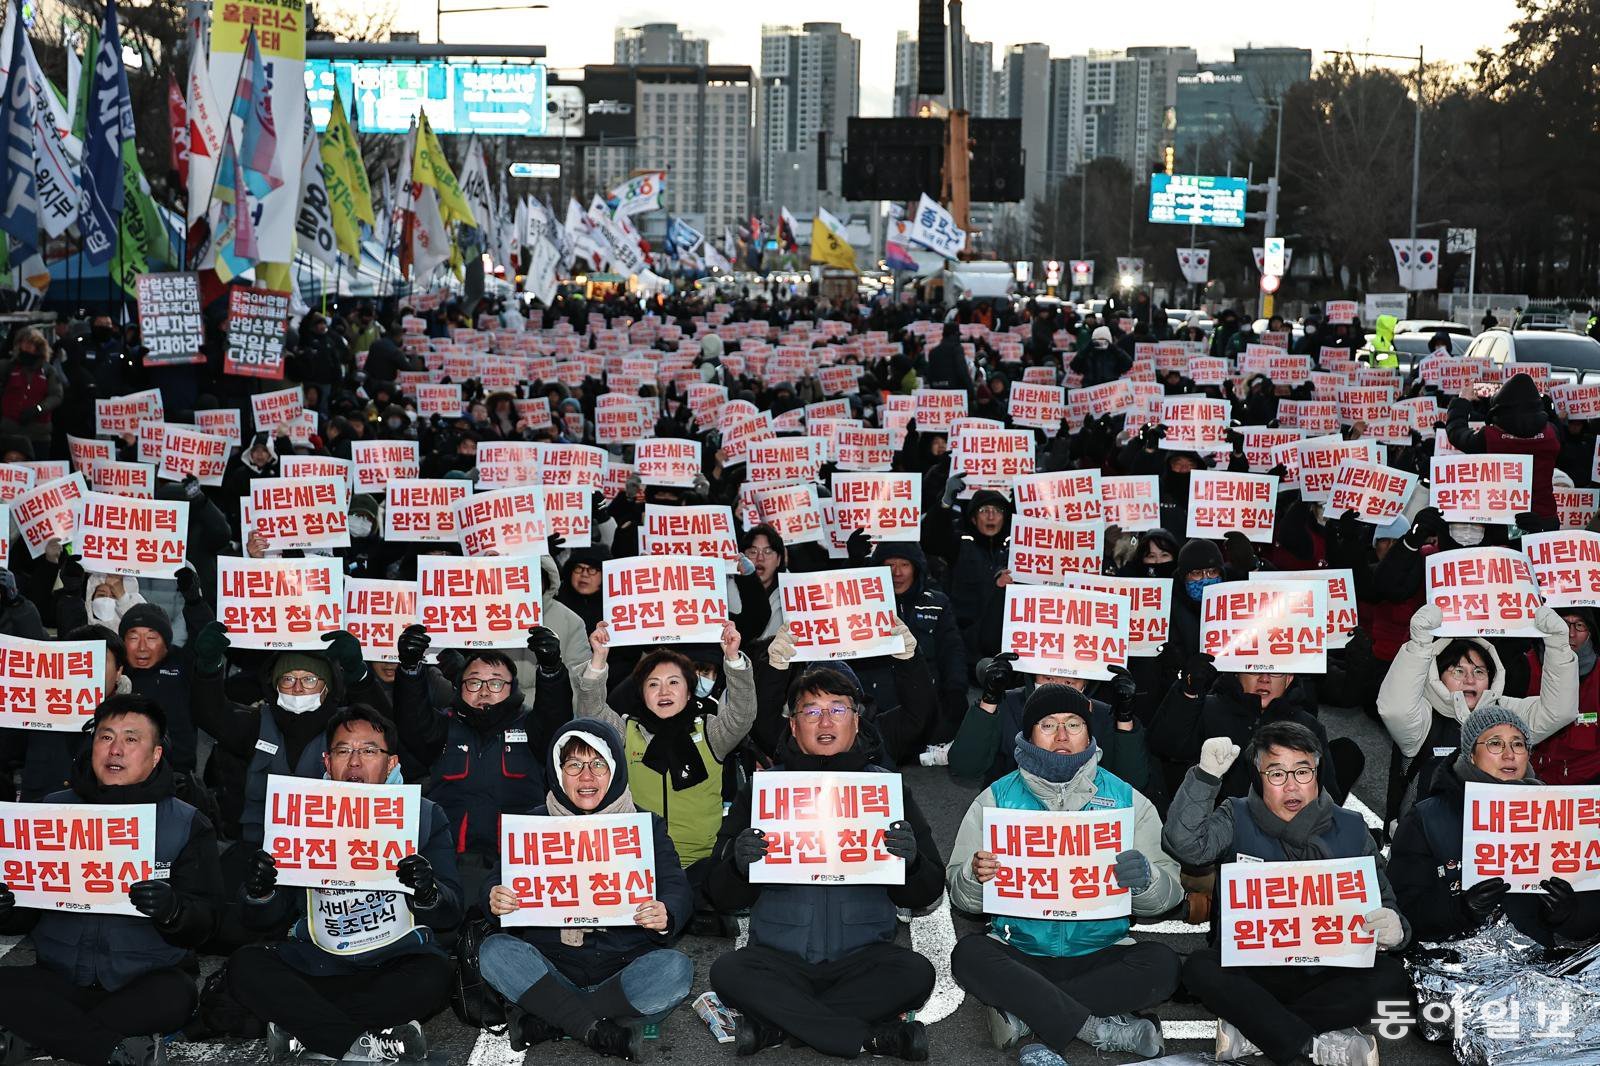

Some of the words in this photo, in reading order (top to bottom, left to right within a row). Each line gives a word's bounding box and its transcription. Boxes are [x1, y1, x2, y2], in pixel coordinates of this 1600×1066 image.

[223, 4, 297, 31] 홈플러스
[230, 316, 284, 336] 산업은행은
[229, 333, 283, 352] 책임을
[228, 347, 282, 367] 다하라
[256, 393, 300, 411] 내란세력
[166, 437, 225, 457] 내란세력
[544, 449, 602, 467] 내란세력
[750, 447, 808, 463] 내란세력
[964, 437, 1028, 453] 내란세력
[166, 456, 195, 474] 완전
[199, 459, 225, 476] 청산
[577, 469, 605, 488] 청산
[640, 462, 668, 476] 완전
[965, 459, 997, 475] 완전
[1003, 458, 1033, 474] 청산
[1435, 462, 1522, 484] 내란세력
[254, 484, 336, 510] 내란세력
[392, 487, 464, 507] 내란세력
[836, 480, 912, 503] 내란세력
[1195, 481, 1270, 502] 내란세력
[1334, 468, 1407, 501] 내란세력
[16, 482, 80, 531] 내란세력
[459, 490, 535, 530] 내란세력
[1064, 501, 1101, 522] 청산
[1333, 491, 1364, 512] 완전
[1366, 496, 1402, 516] 청산
[1438, 489, 1480, 510] 완전
[1488, 488, 1530, 511] 청산
[84, 505, 176, 532] 내란세력
[256, 515, 299, 540] 완전
[304, 512, 346, 535] 청산
[394, 512, 430, 530] 완전
[650, 514, 728, 536] 내란세력
[839, 508, 872, 530] 완전
[878, 507, 919, 528] 청산
[1196, 508, 1236, 528] 완전
[1242, 507, 1273, 528] 청산
[84, 534, 128, 560] 완전
[136, 538, 184, 564] 청산
[465, 526, 496, 556] 완전
[502, 522, 544, 546] 청산
[1015, 528, 1095, 551] 내란세력
[1016, 553, 1055, 575] 완전
[1060, 556, 1101, 576] 청산
[1432, 558, 1530, 588] 내란세력
[223, 569, 330, 598] 내란세력
[423, 566, 530, 597] 내란세력
[609, 566, 715, 597] 내란세력
[784, 578, 884, 612] 내란세력
[224, 607, 277, 633] 완전
[285, 604, 341, 632] 청산
[423, 605, 477, 633] 완전
[486, 603, 540, 632] 청산
[612, 602, 664, 631] 완전
[673, 599, 730, 630] 청산
[1011, 598, 1118, 628] 내란세력
[1206, 592, 1313, 622] 내란세력
[1435, 594, 1490, 621] 완전
[348, 623, 394, 648] 완전
[790, 618, 840, 646] 완전
[848, 612, 896, 640] 청산
[1268, 627, 1324, 655] 청산
[1012, 632, 1064, 658] 완전
[1074, 634, 1126, 664] 청산
[46, 688, 102, 715] 청산
[273, 794, 403, 829] 내란세력
[760, 786, 890, 820] 내란세력
[1472, 798, 1600, 832] 내란세력
[0, 818, 138, 851] 내란세력
[509, 826, 640, 865] 내란세력
[763, 832, 826, 864] 완전
[838, 828, 901, 862] 청산
[992, 822, 1120, 858] 내란세력
[272, 837, 336, 870] 완전
[348, 840, 415, 870] 청산
[1475, 843, 1540, 876] 완전
[4, 861, 70, 893] 완전
[81, 861, 152, 893] 청산
[513, 875, 579, 908] 완전
[589, 870, 653, 906] 청산
[821, 874, 846, 882] 민주노총
[995, 866, 1058, 900] 완전
[1230, 870, 1366, 909] 내란세력
[65, 902, 91, 910] 민주노총
[325, 904, 397, 937] 동조단식
[573, 917, 600, 925] 민주노총
[1234, 917, 1301, 950] 완전
[1312, 915, 1374, 944] 청산
